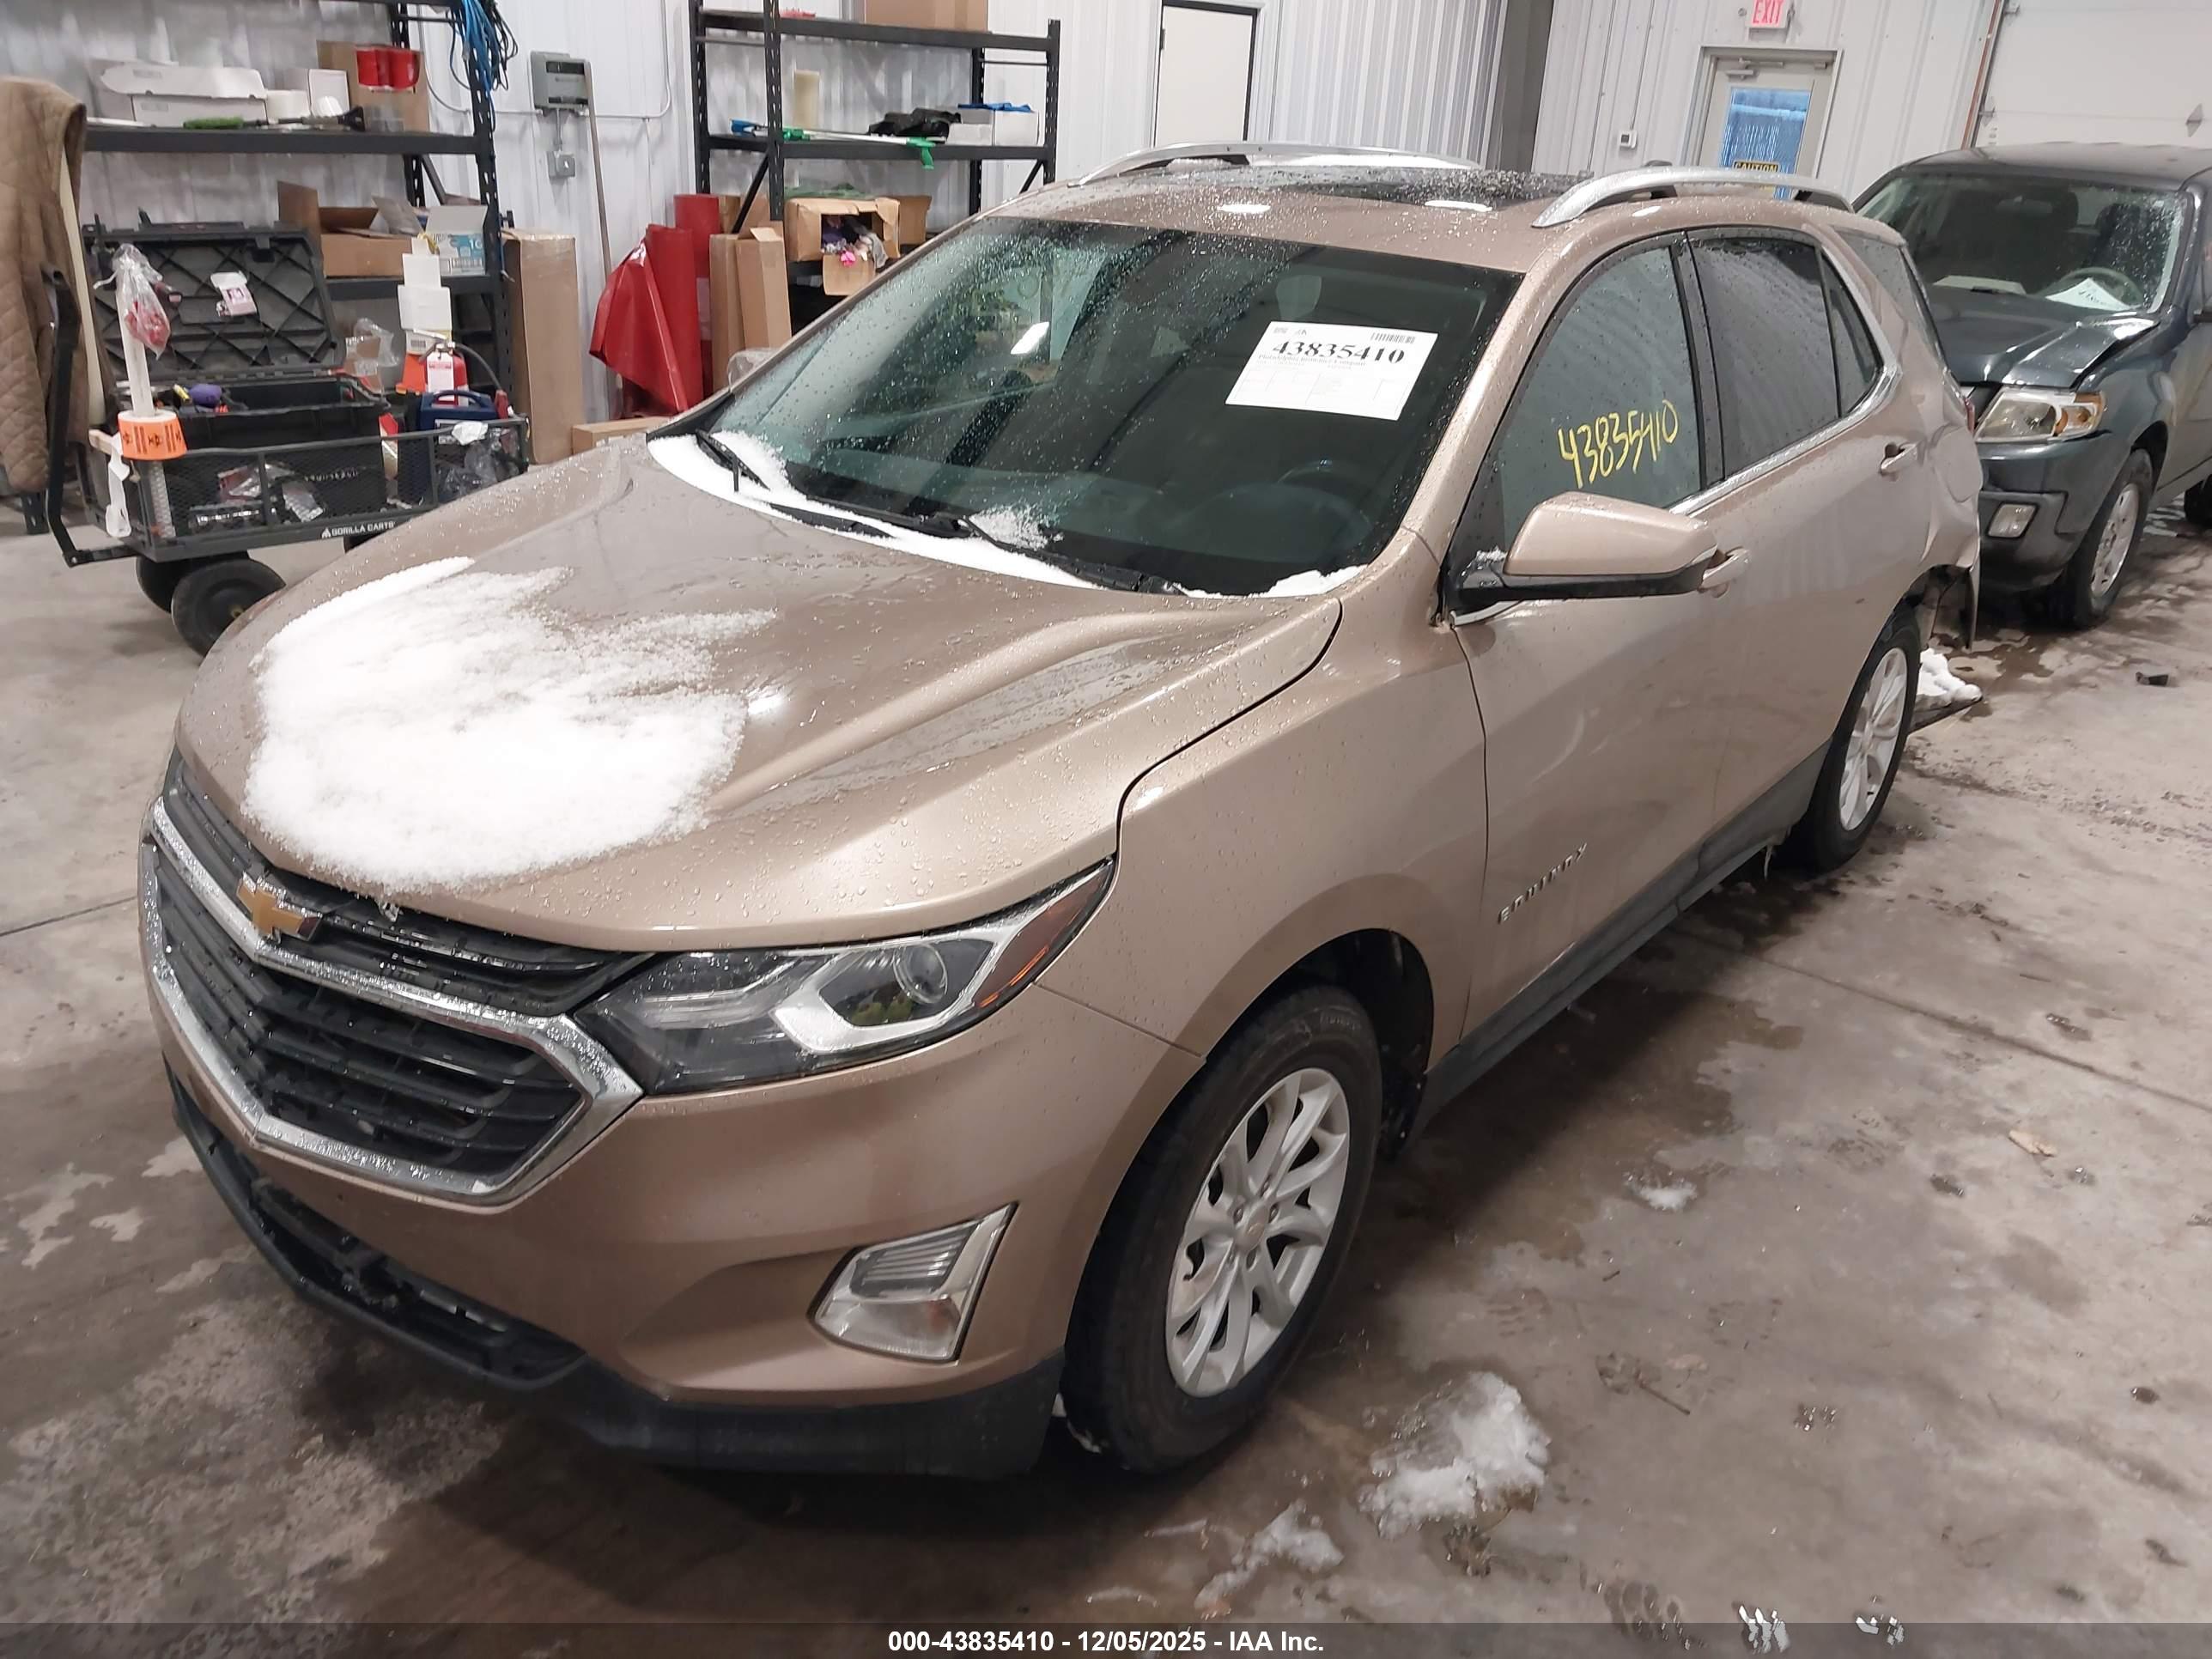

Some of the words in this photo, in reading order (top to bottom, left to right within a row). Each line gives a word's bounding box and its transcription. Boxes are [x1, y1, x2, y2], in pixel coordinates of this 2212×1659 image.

[1753, 0, 1784, 24] EXIT
[1273, 341, 1405, 364] 43835410
[1558, 399, 1679, 489] 43835410
[331, 525, 366, 537] GORILLA
[367, 520, 395, 532] CARTS
